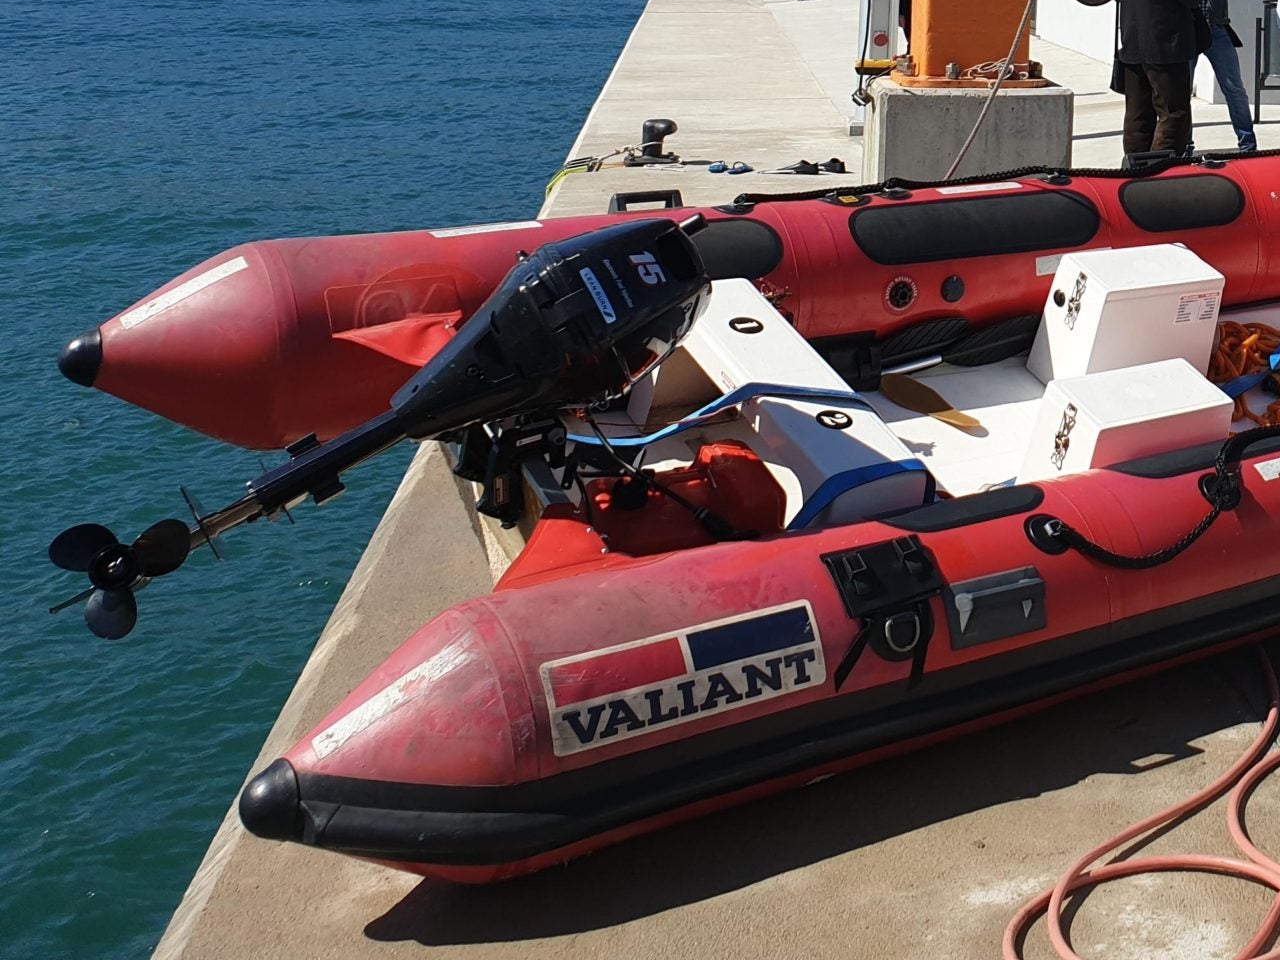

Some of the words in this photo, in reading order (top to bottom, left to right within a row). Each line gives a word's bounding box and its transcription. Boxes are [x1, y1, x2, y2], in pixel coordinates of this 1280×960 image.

[628, 251, 667, 286] 15
[584, 272, 598, 291] LEAN
[595, 291, 608, 310] BURN
[734, 320, 759, 330] 1
[820, 413, 848, 426] 2
[562, 648, 816, 744] VALIANT
